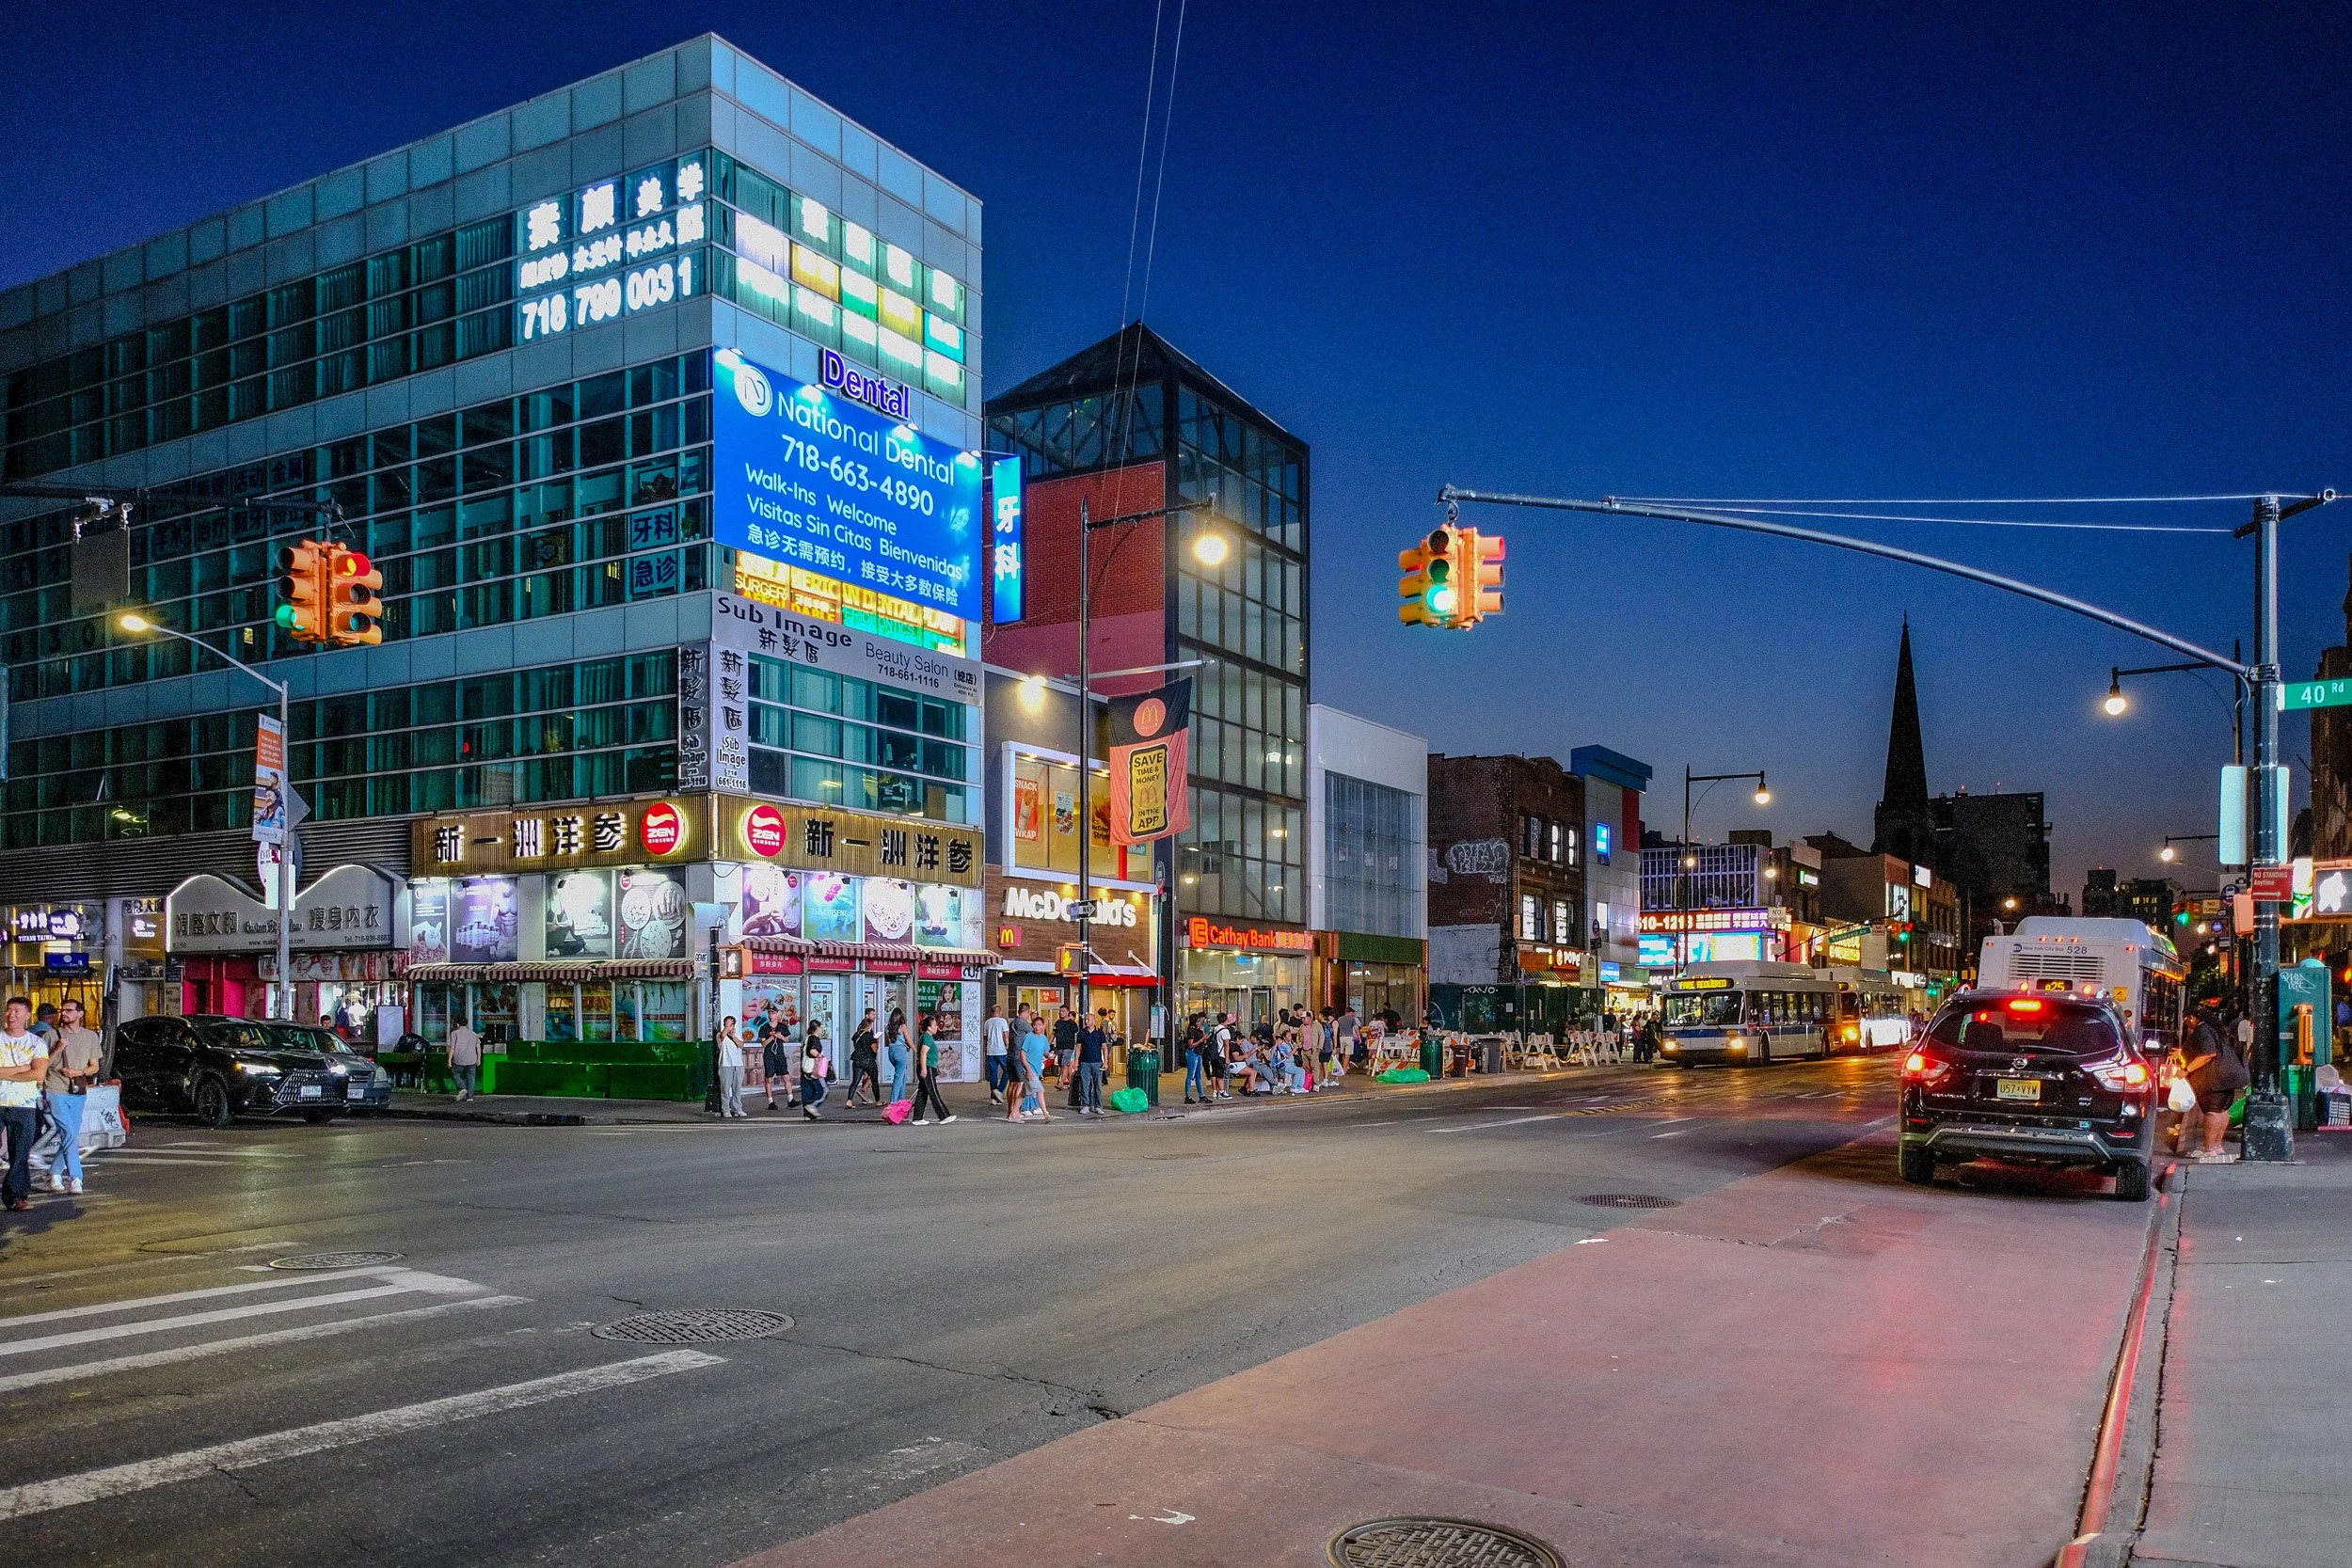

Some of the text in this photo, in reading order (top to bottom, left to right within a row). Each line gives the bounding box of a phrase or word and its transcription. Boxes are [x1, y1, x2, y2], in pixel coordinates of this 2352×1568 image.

[522, 293, 566, 339] 718
[822, 348, 911, 420] Dental
[778, 391, 954, 485] National Dental
[781, 434, 934, 516] 718-663-4890
[745, 463, 898, 536] Walk-Ins Welcome
[632, 511, 674, 544] 牙科
[747, 494, 962, 580] Visitas Sin Citas Bienvenidas
[994, 495, 1021, 581] 牙科
[635, 555, 677, 588] 急诊
[718, 597, 852, 647] Sub Image
[866, 641, 911, 671] Beauty
[914, 656, 948, 677] Salon
[878, 664, 940, 689] 718-661-1116
[2300, 682, 2344, 705] 40 Rd
[684, 735, 701, 751] Sub
[723, 736, 739, 751] Sub
[679, 751, 707, 766] Image
[718, 750, 746, 767] Image
[1134, 752, 1164, 768] SAVE
[717, 776, 747, 789] 661-1116
[1015, 780, 1038, 792] SNACK
[1136, 773, 1160, 784] MONEY
[1137, 816, 1160, 830] APP
[1146, 807, 1160, 816] THE
[646, 828, 675, 839] ZEN
[752, 829, 780, 841] ZEN
[1015, 830, 1037, 840] WRAP
[1004, 887, 1137, 927] McDoald's
[1210, 925, 1248, 950] Cathay
[1248, 930, 1276, 948] Bank
[2067, 945, 2088, 955] 528
